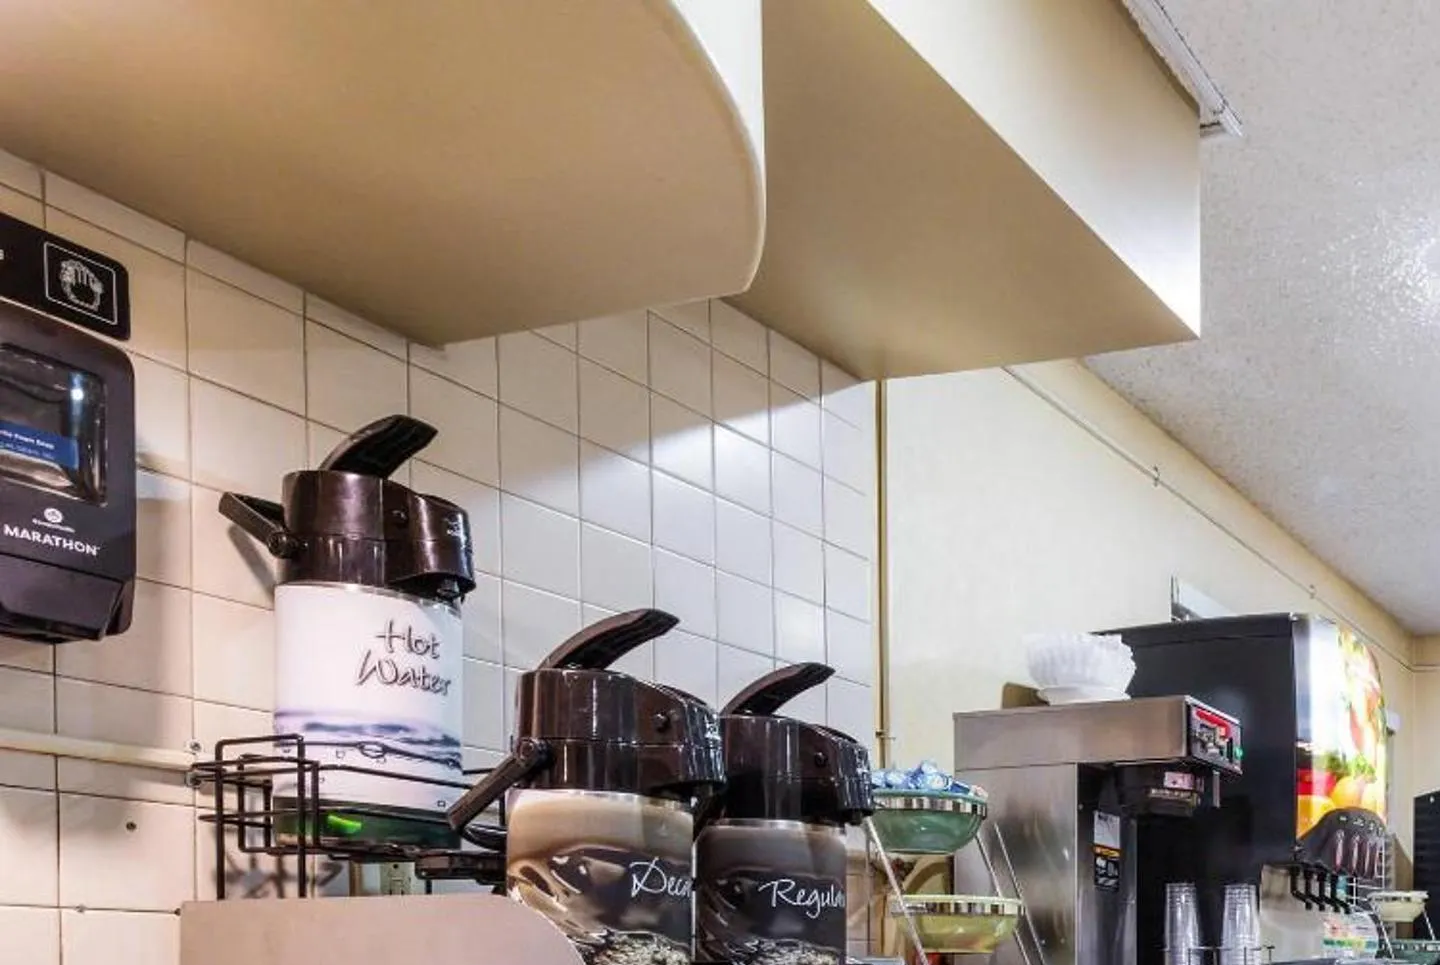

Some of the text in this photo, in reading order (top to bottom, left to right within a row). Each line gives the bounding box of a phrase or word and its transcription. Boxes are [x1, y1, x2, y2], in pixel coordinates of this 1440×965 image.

[3, 523, 97, 556] MARATHON
[376, 619, 440, 659] Hot
[356, 649, 451, 695] Water
